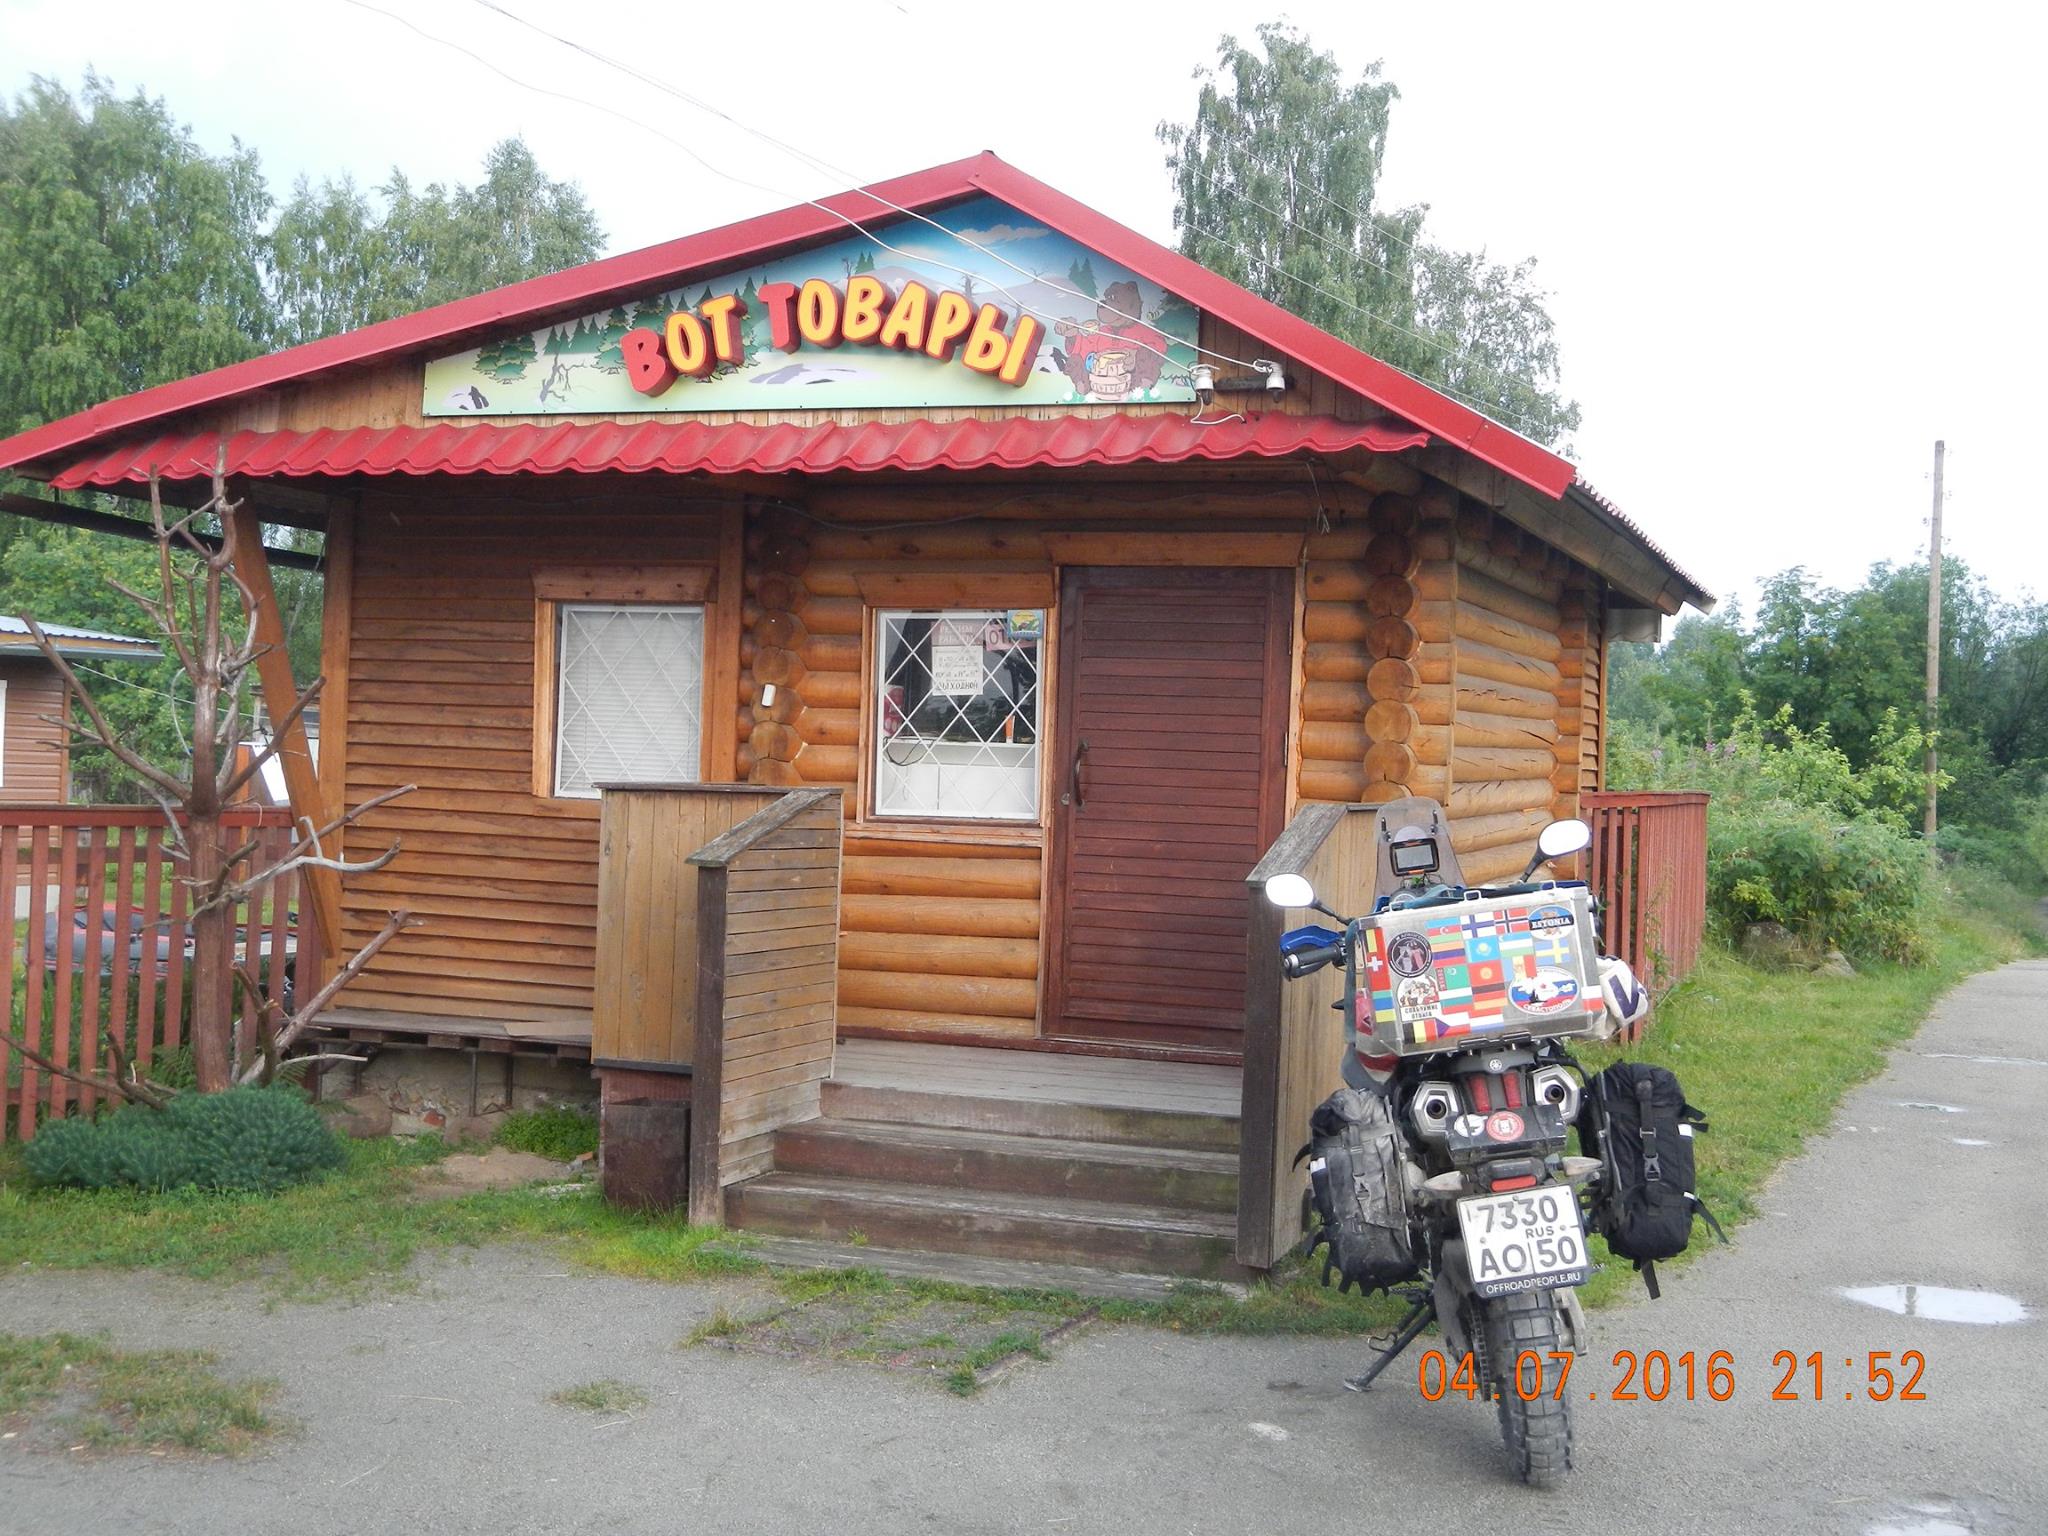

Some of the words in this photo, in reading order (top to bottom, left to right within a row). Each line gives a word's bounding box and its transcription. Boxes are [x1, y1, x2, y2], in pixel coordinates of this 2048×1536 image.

[621, 294, 747, 398] ВОТ
[758, 275, 1046, 387] ТОВАРЫ
[1477, 1195, 1559, 1233] 7330
[1525, 1225, 1554, 1239] RUS
[1536, 1236, 1578, 1267] 50
[1486, 1271, 1581, 1295] OFFROADPEOPLE.RU
